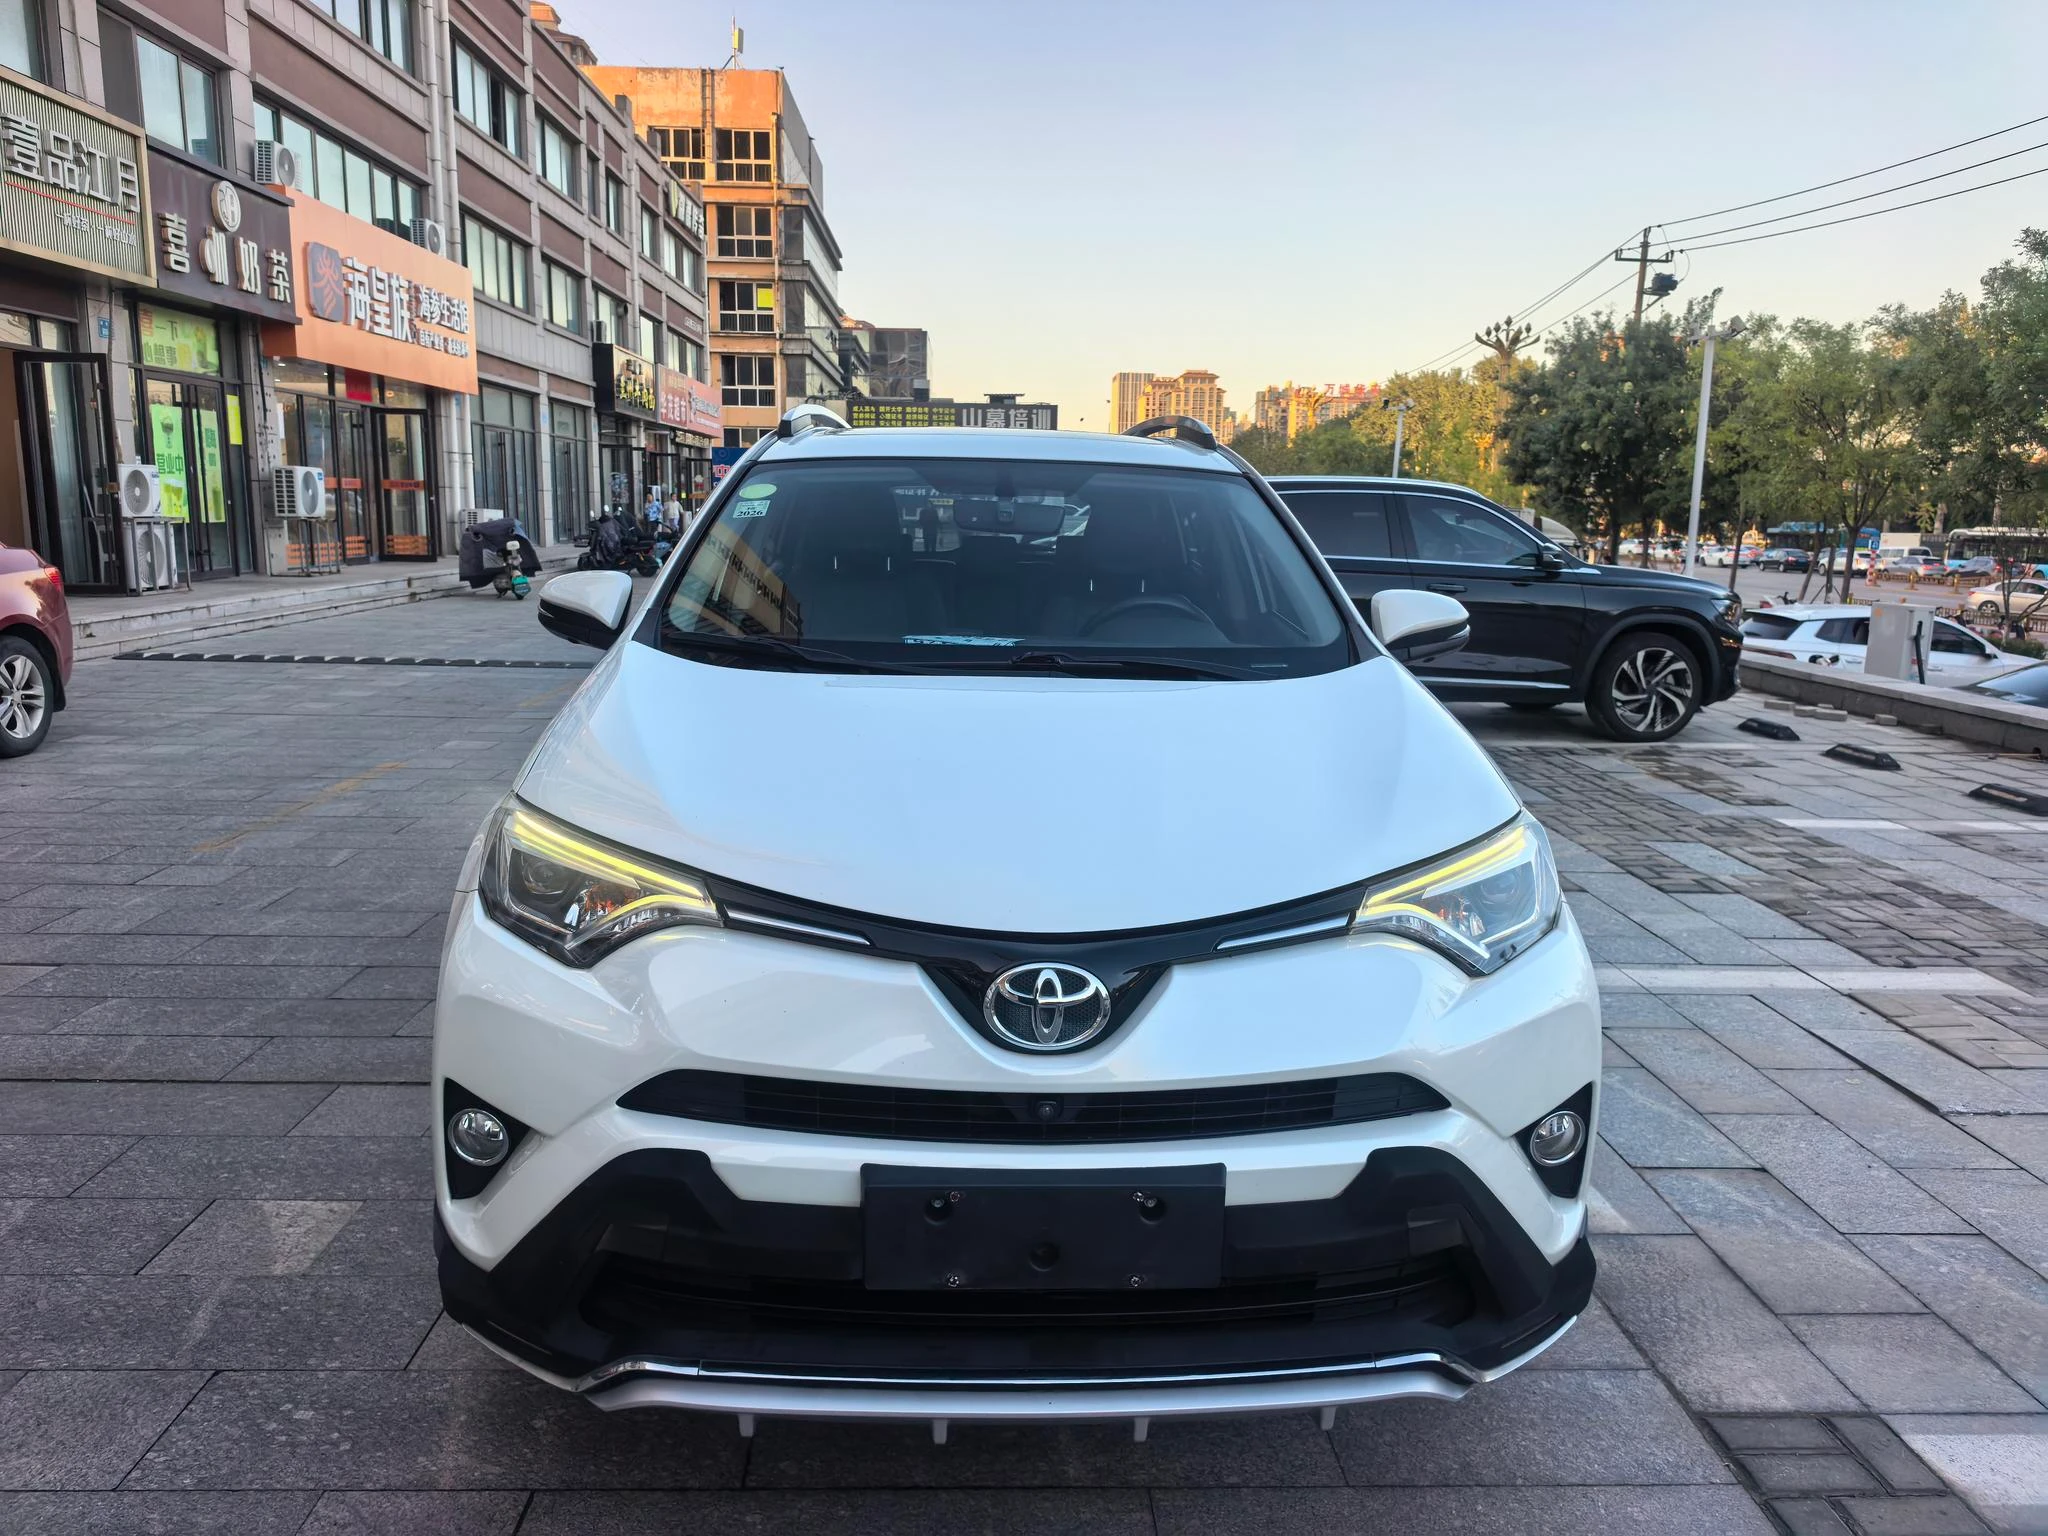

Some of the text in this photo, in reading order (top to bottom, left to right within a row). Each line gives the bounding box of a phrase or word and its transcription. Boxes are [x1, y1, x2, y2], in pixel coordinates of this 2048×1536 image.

[2, 113, 140, 213] 壹品江月
[343, 256, 412, 343] 海皇族
[418, 285, 469, 334] 海参生活馆
[156, 453, 185, 475] 营业中
[737, 509, 763, 517] 2026
